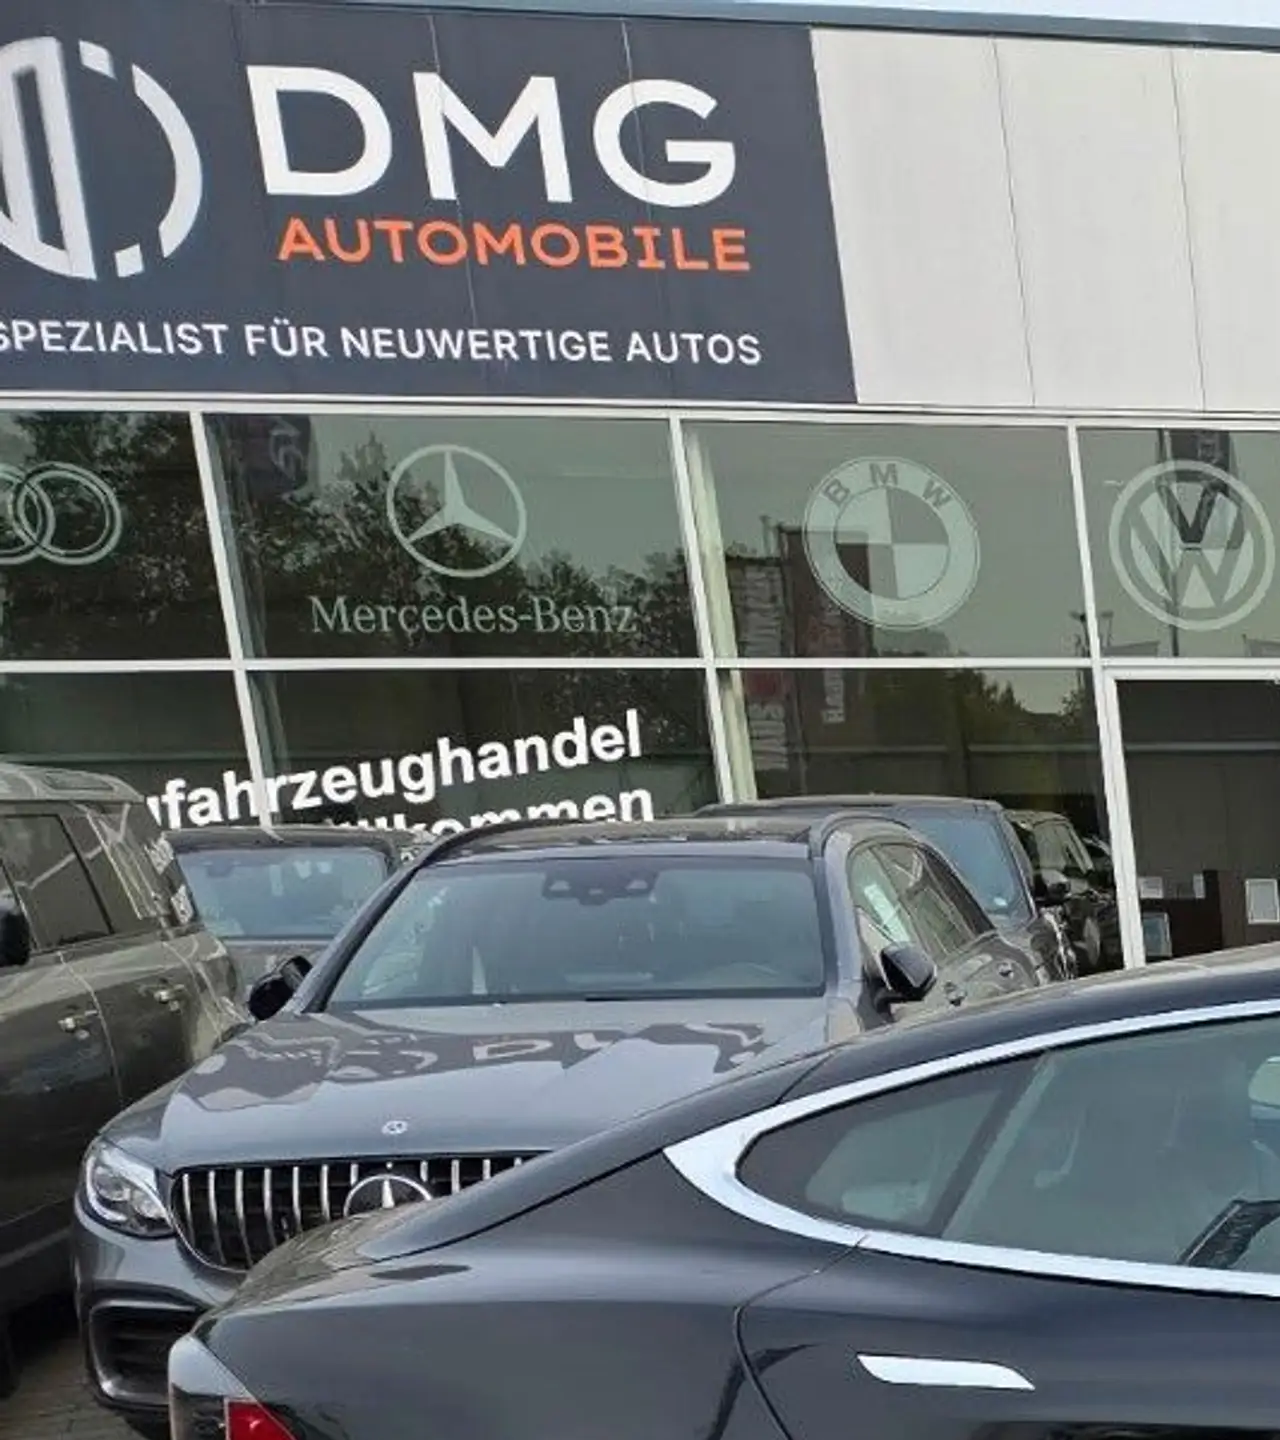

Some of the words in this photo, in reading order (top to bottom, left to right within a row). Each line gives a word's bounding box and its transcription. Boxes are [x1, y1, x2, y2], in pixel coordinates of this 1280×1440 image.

[246, 64, 737, 207] DMG
[278, 216, 750, 272] AUTOMOBILE
[246, 318, 328, 358] FÜR
[342, 325, 611, 363] NEUWERTIGE
[625, 332, 762, 366] AUTOS
[310, 597, 638, 635] Mercedes-Benz
